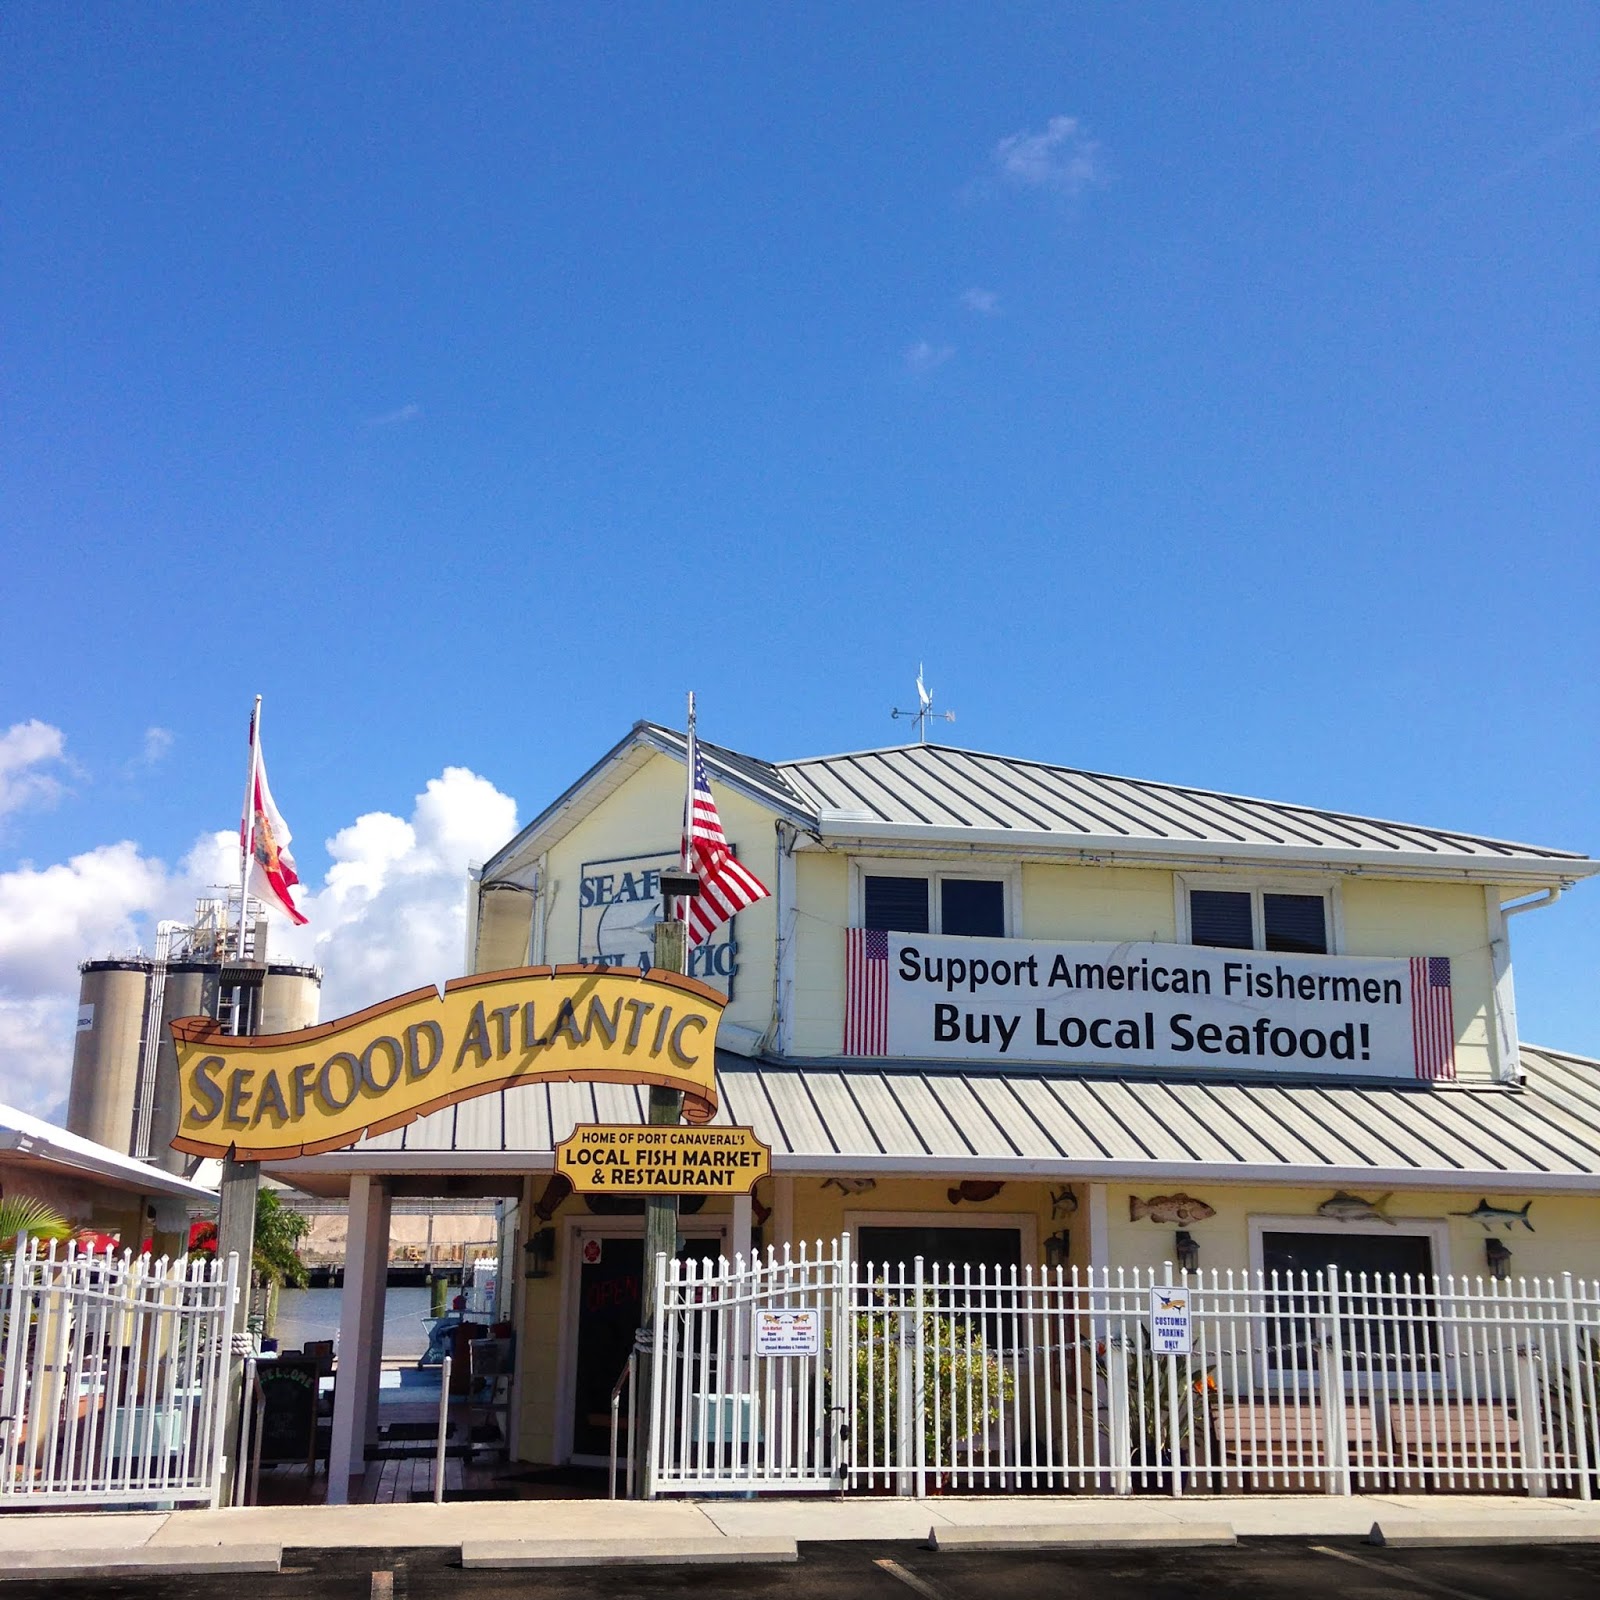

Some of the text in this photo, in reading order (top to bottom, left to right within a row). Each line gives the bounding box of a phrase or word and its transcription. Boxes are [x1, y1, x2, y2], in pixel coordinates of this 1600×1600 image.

[579, 866, 682, 908] SEAF
[898, 946, 1402, 1005] Support American Fishermen
[934, 1003, 1370, 1061] Buy Local Seafood!
[188, 995, 708, 1126] SEAFOOD ATLANTIC
[582, 1132, 745, 1146] HOME OF PORT CANAVERAL'S
[566, 1149, 762, 1168] LOCAL FISH MARKET
[591, 1168, 736, 1186] & RESTAURANT
[1155, 1316, 1187, 1326] CUSTOMER
[1158, 1328, 1184, 1338] PARKING
[1164, 1340, 1179, 1349] ONLY
